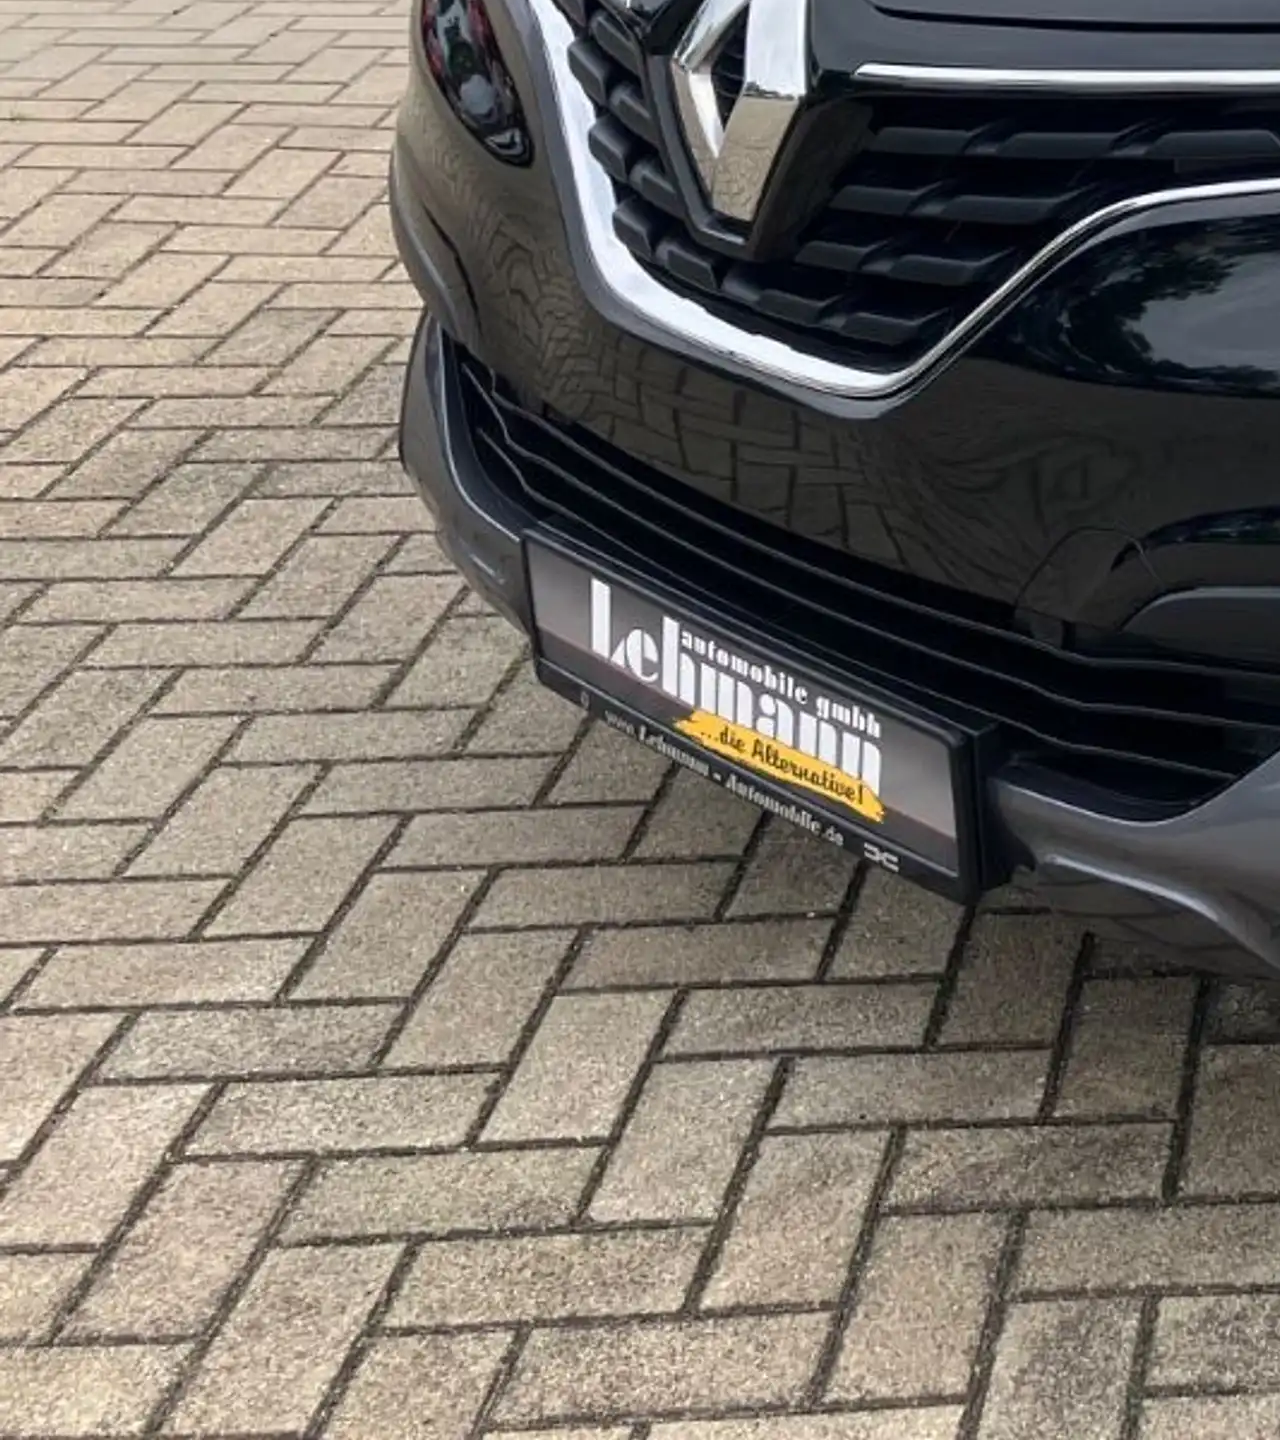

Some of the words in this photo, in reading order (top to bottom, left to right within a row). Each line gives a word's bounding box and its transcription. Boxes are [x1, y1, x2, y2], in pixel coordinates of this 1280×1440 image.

[591, 577, 882, 797] Lehmann
[681, 630, 808, 705] automobile
[815, 694, 881, 739] gmbh
[751, 737, 864, 806] Alternative!
